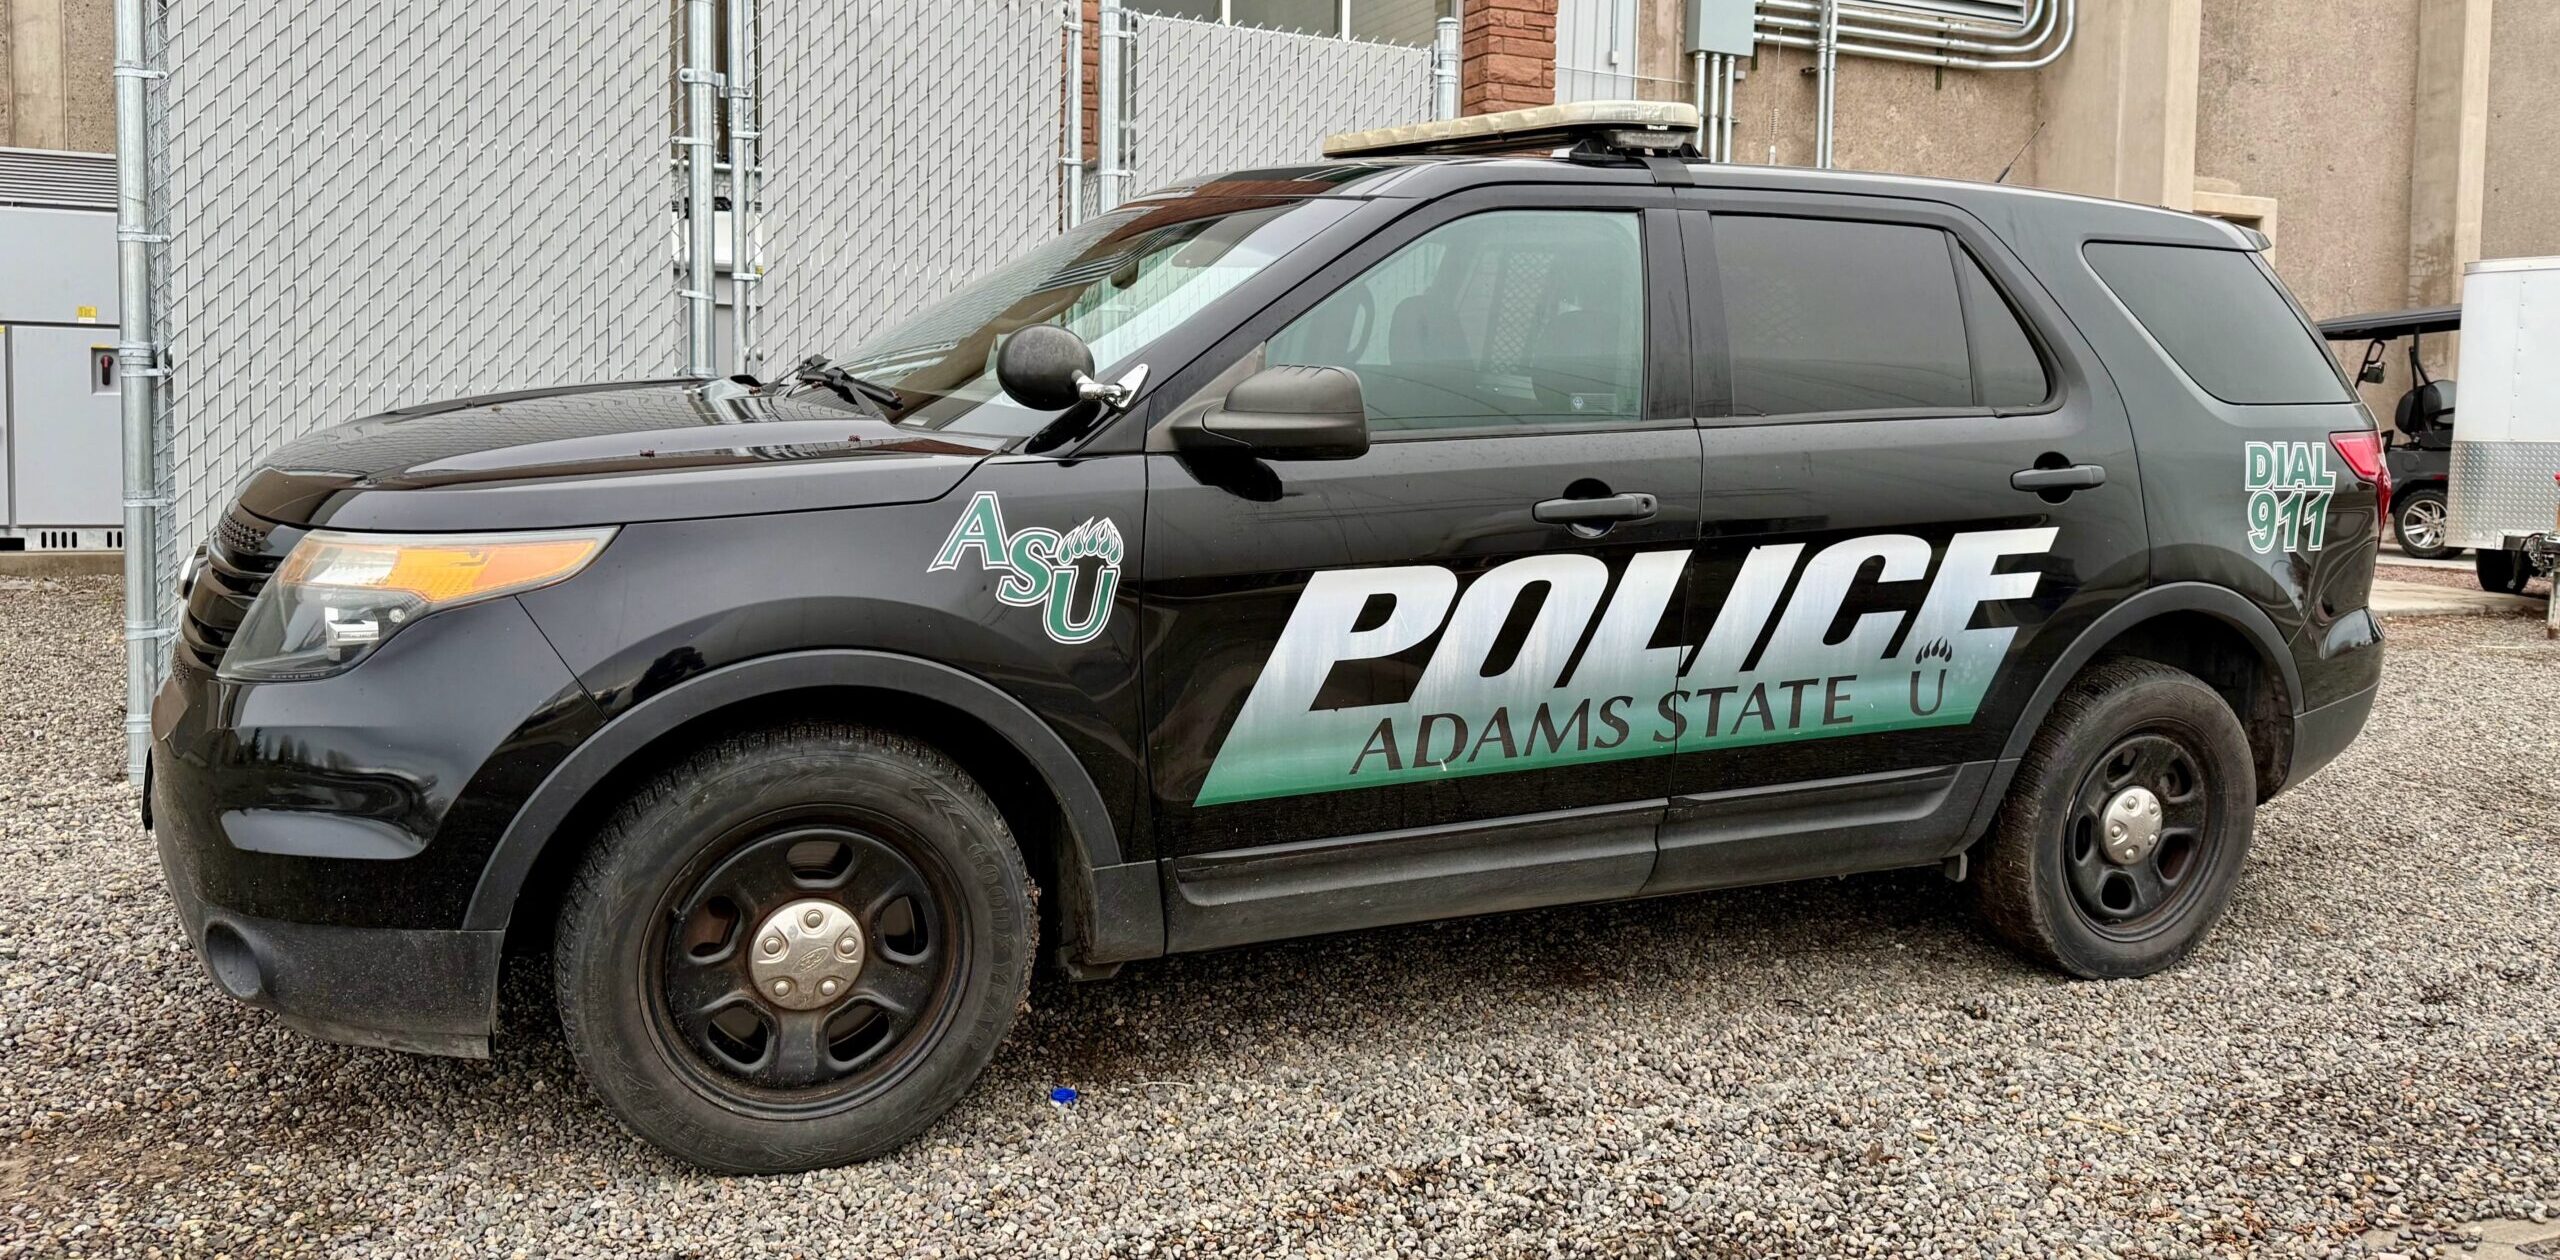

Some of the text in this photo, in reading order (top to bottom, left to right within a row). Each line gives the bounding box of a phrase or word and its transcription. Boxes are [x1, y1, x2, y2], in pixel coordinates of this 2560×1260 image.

[2245, 441, 2336, 491] DIAL
[926, 490, 1121, 645] ASU
[2248, 488, 2335, 554] 911
[1245, 526, 2059, 714] POLICE
[1349, 695, 1633, 775] ADAMS
[1653, 674, 1858, 743] STATE
